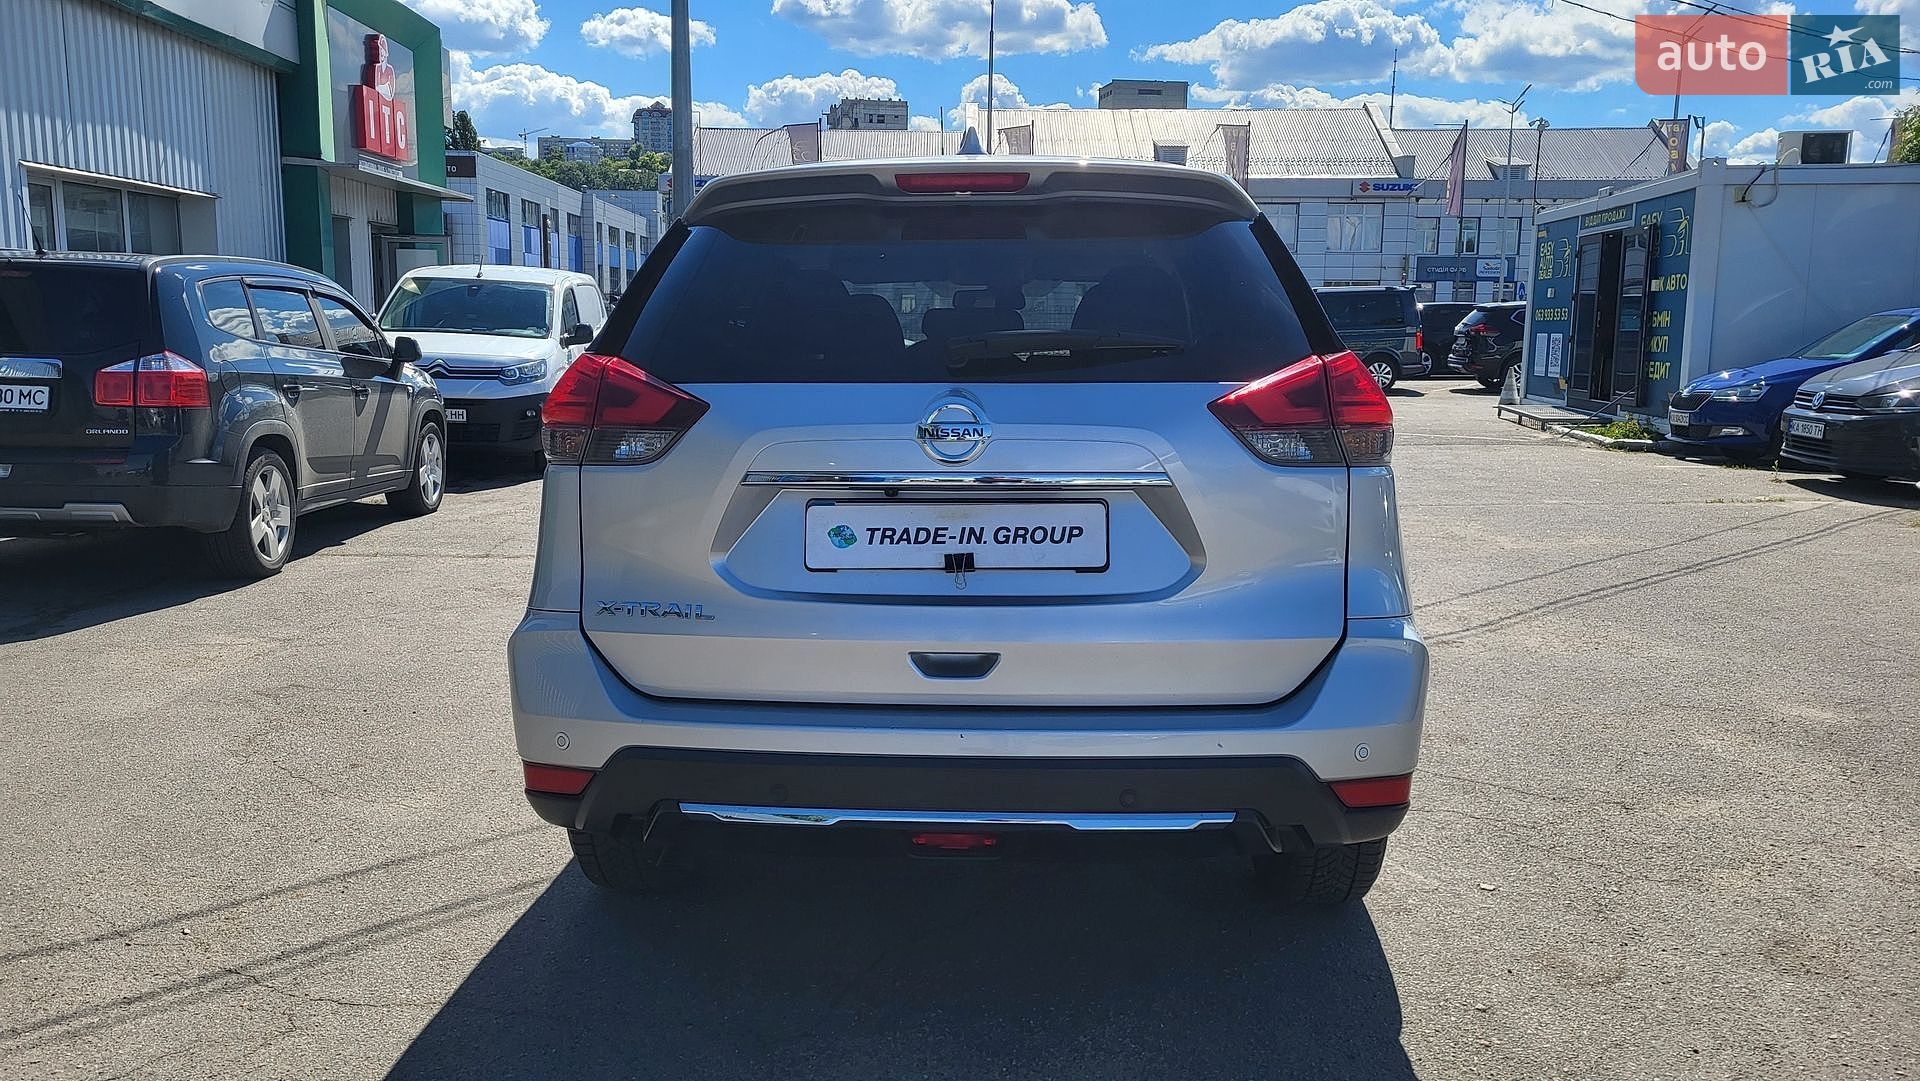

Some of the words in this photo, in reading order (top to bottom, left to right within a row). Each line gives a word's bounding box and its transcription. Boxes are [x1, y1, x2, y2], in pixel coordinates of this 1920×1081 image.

[1540, 241, 1555, 257] EASY
[1648, 361, 1671, 380] ЕДИТ
[923, 427, 984, 438] NISSAN
[595, 600, 716, 620] X-TRAIL
